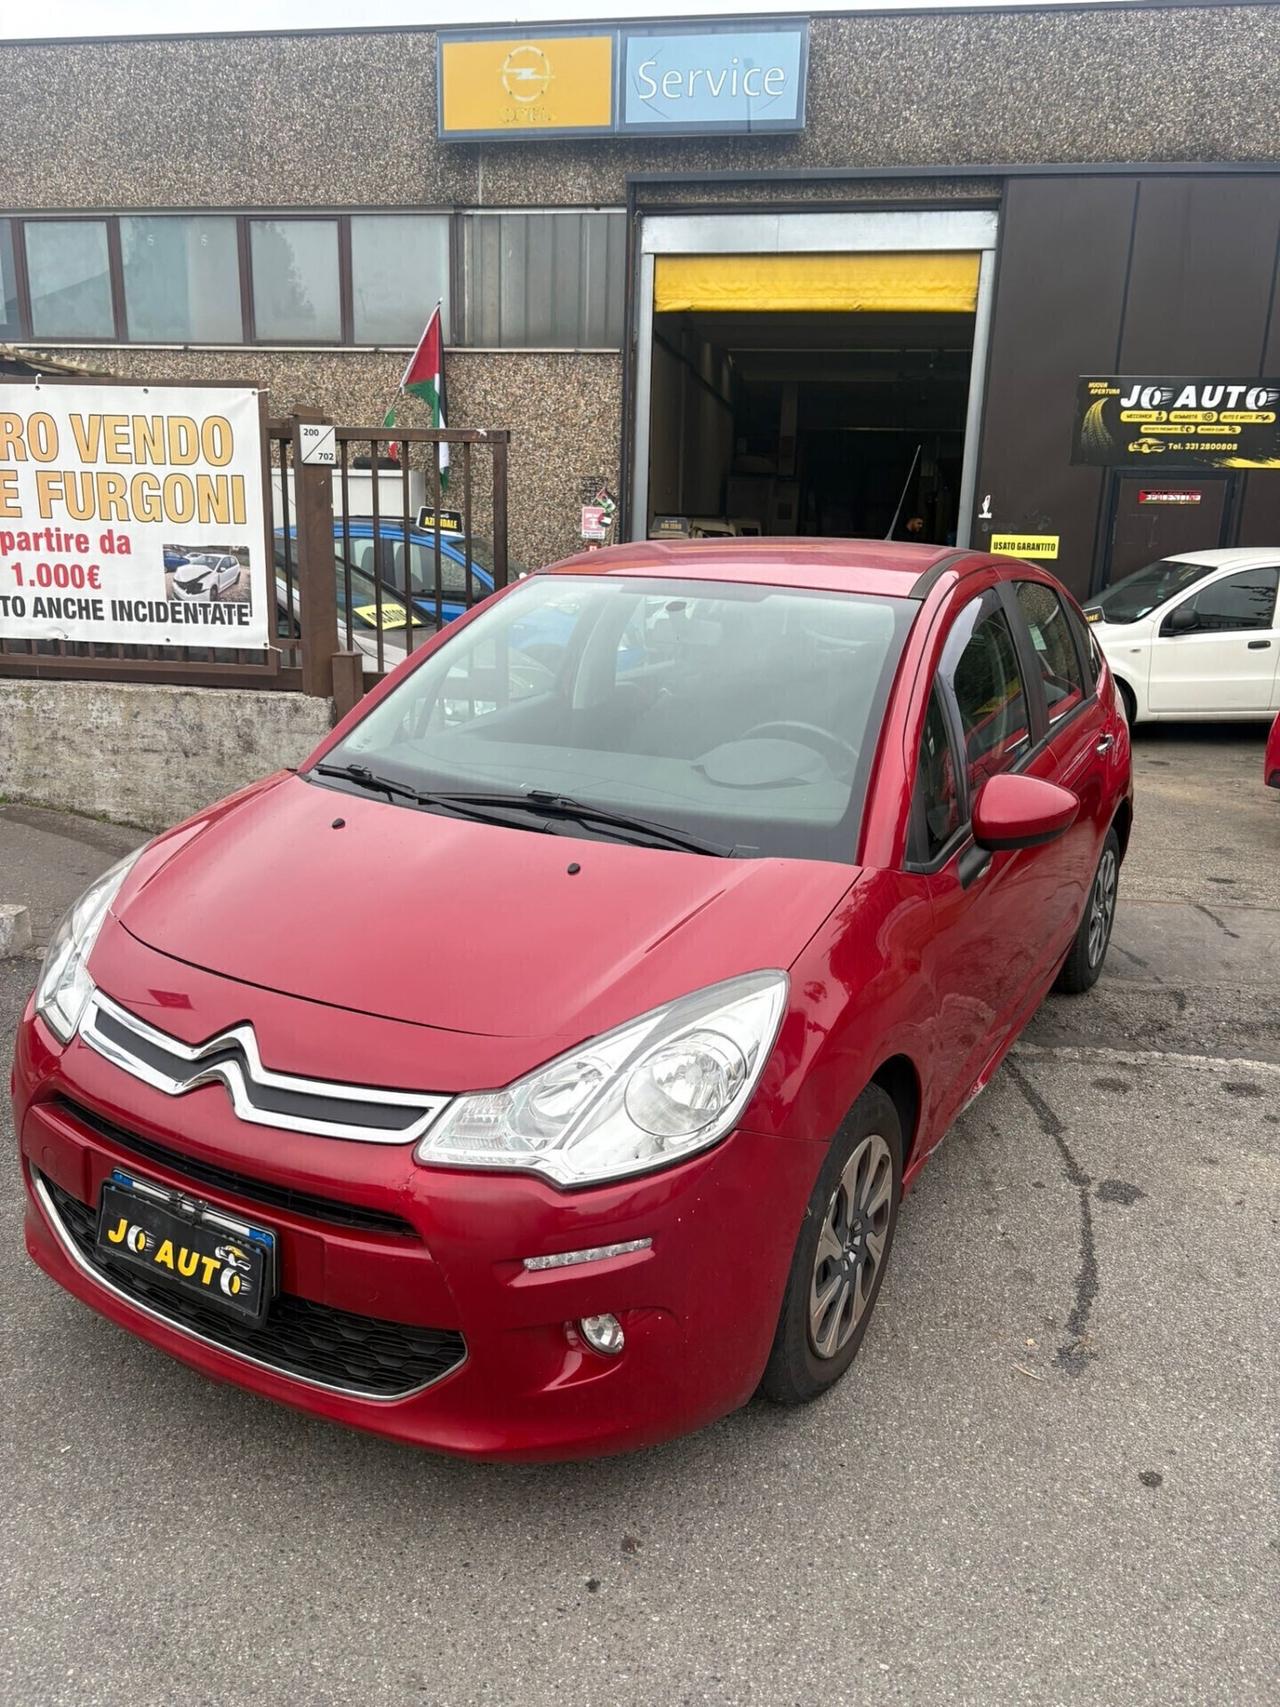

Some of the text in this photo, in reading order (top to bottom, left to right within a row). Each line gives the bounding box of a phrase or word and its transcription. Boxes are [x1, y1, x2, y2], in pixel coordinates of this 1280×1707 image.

[638, 58, 785, 99] Service
[1173, 385, 1268, 410] AUTO
[69, 414, 234, 466] VENDO
[304, 428, 320, 436] 200
[1168, 442, 1184, 450] Tel.
[318, 452, 334, 460] 702
[0, 470, 247, 524] E FURGONI
[424, 516, 458, 529] AZINDALE
[1, 527, 131, 557] partire da
[994, 541, 1057, 551] USATO GARANTITO
[12, 562, 102, 590] 1.000€
[0, 596, 250, 626] TO ANCHE INCIDENTATE
[154, 1240, 242, 1298] AUTO
